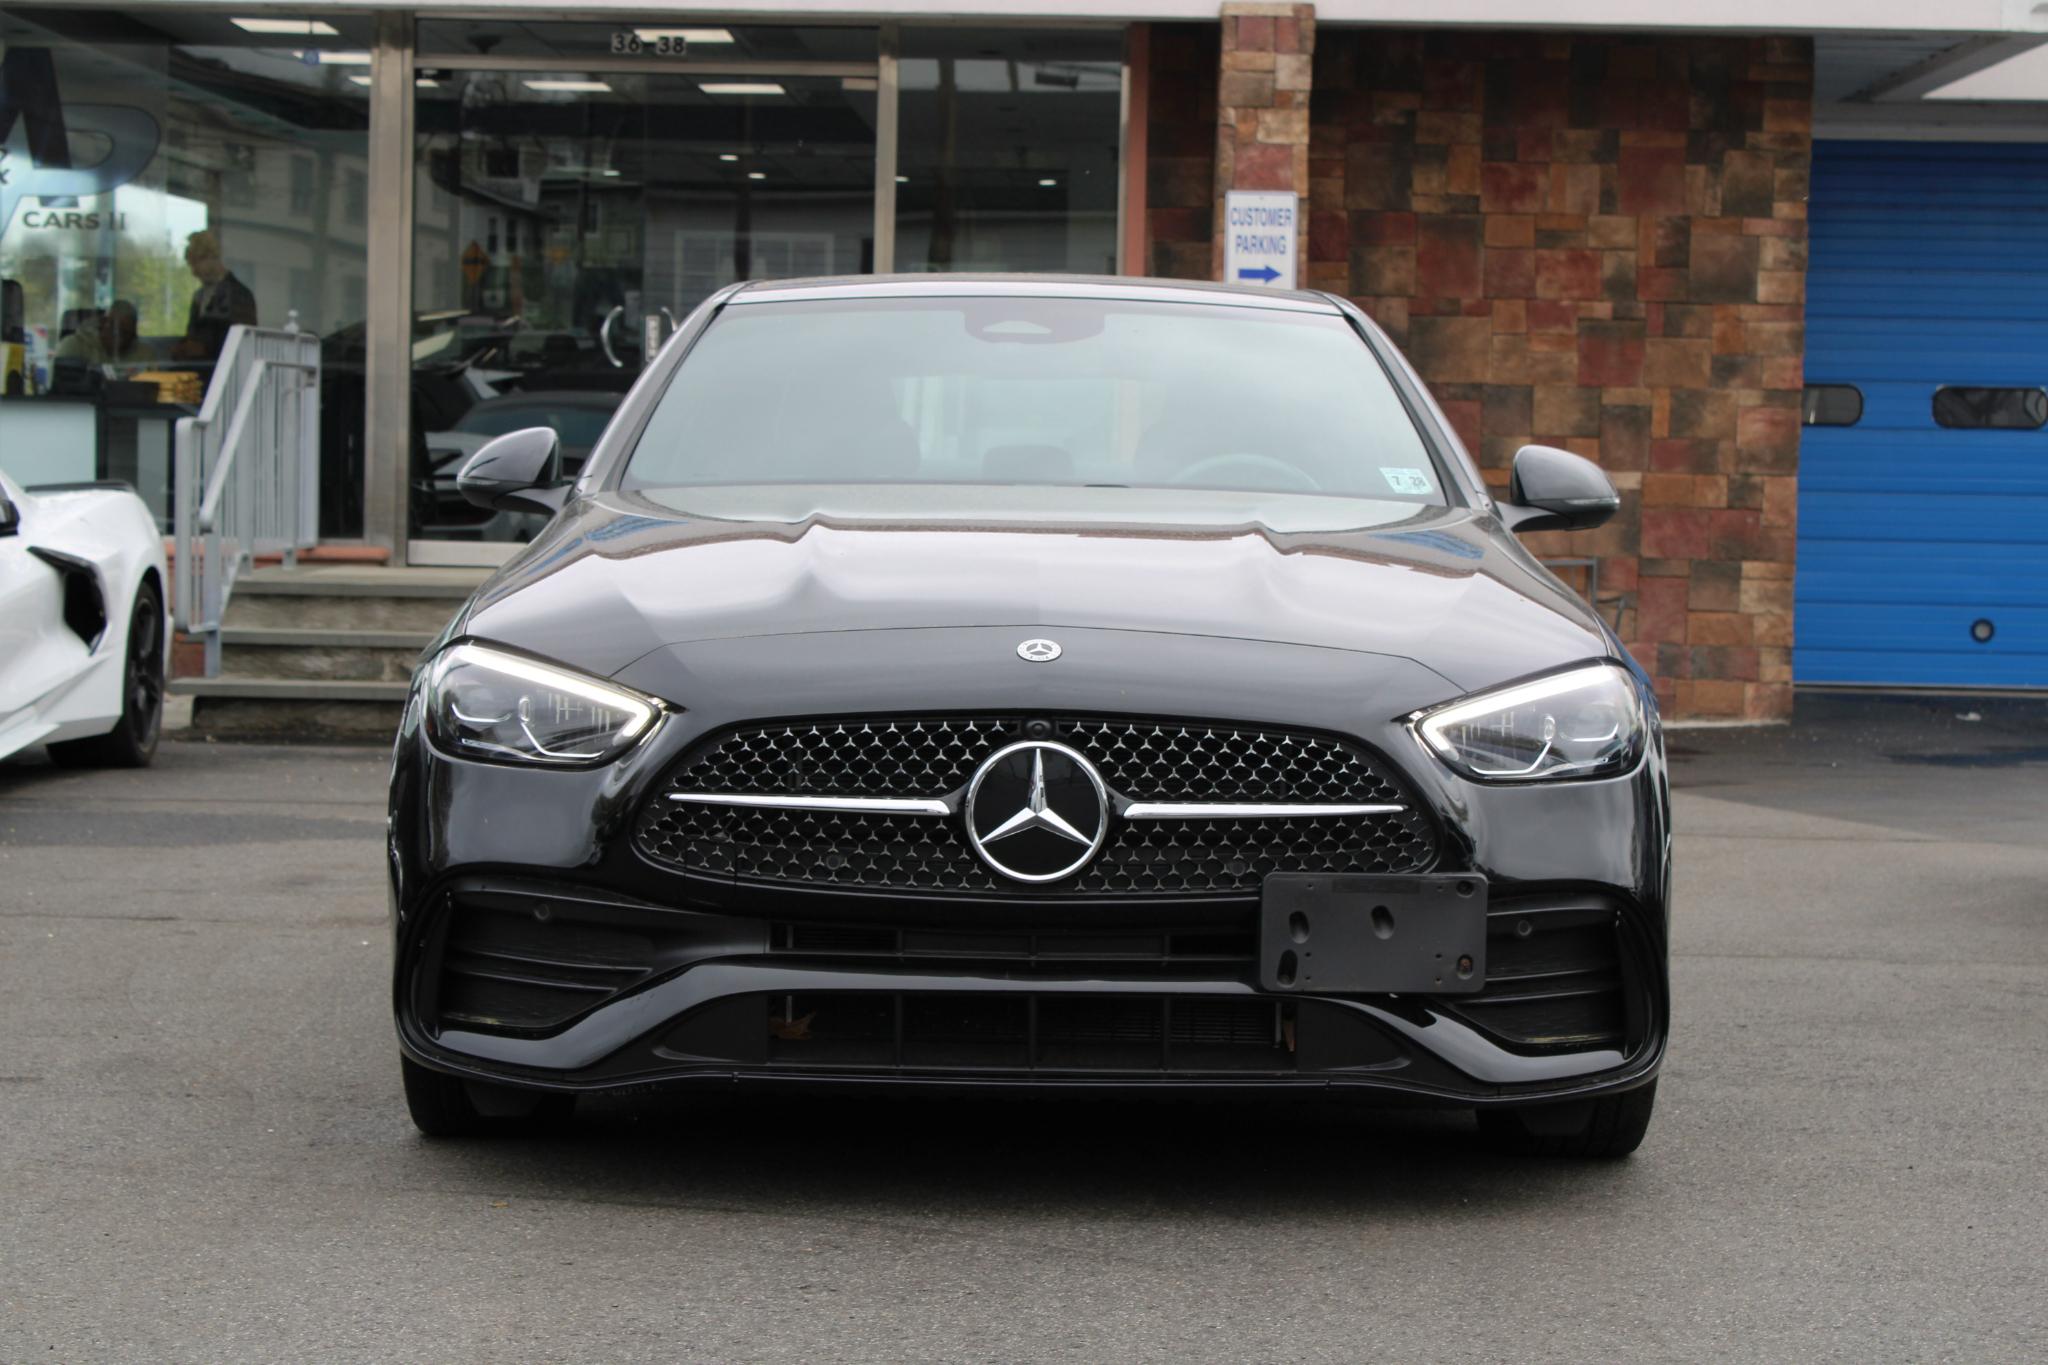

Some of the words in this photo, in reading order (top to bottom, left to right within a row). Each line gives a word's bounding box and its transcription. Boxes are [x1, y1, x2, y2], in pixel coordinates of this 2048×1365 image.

[22, 210, 101, 230] CARS
[1231, 207, 1292, 226] CUSTOMER
[1235, 234, 1287, 255] PARKING
